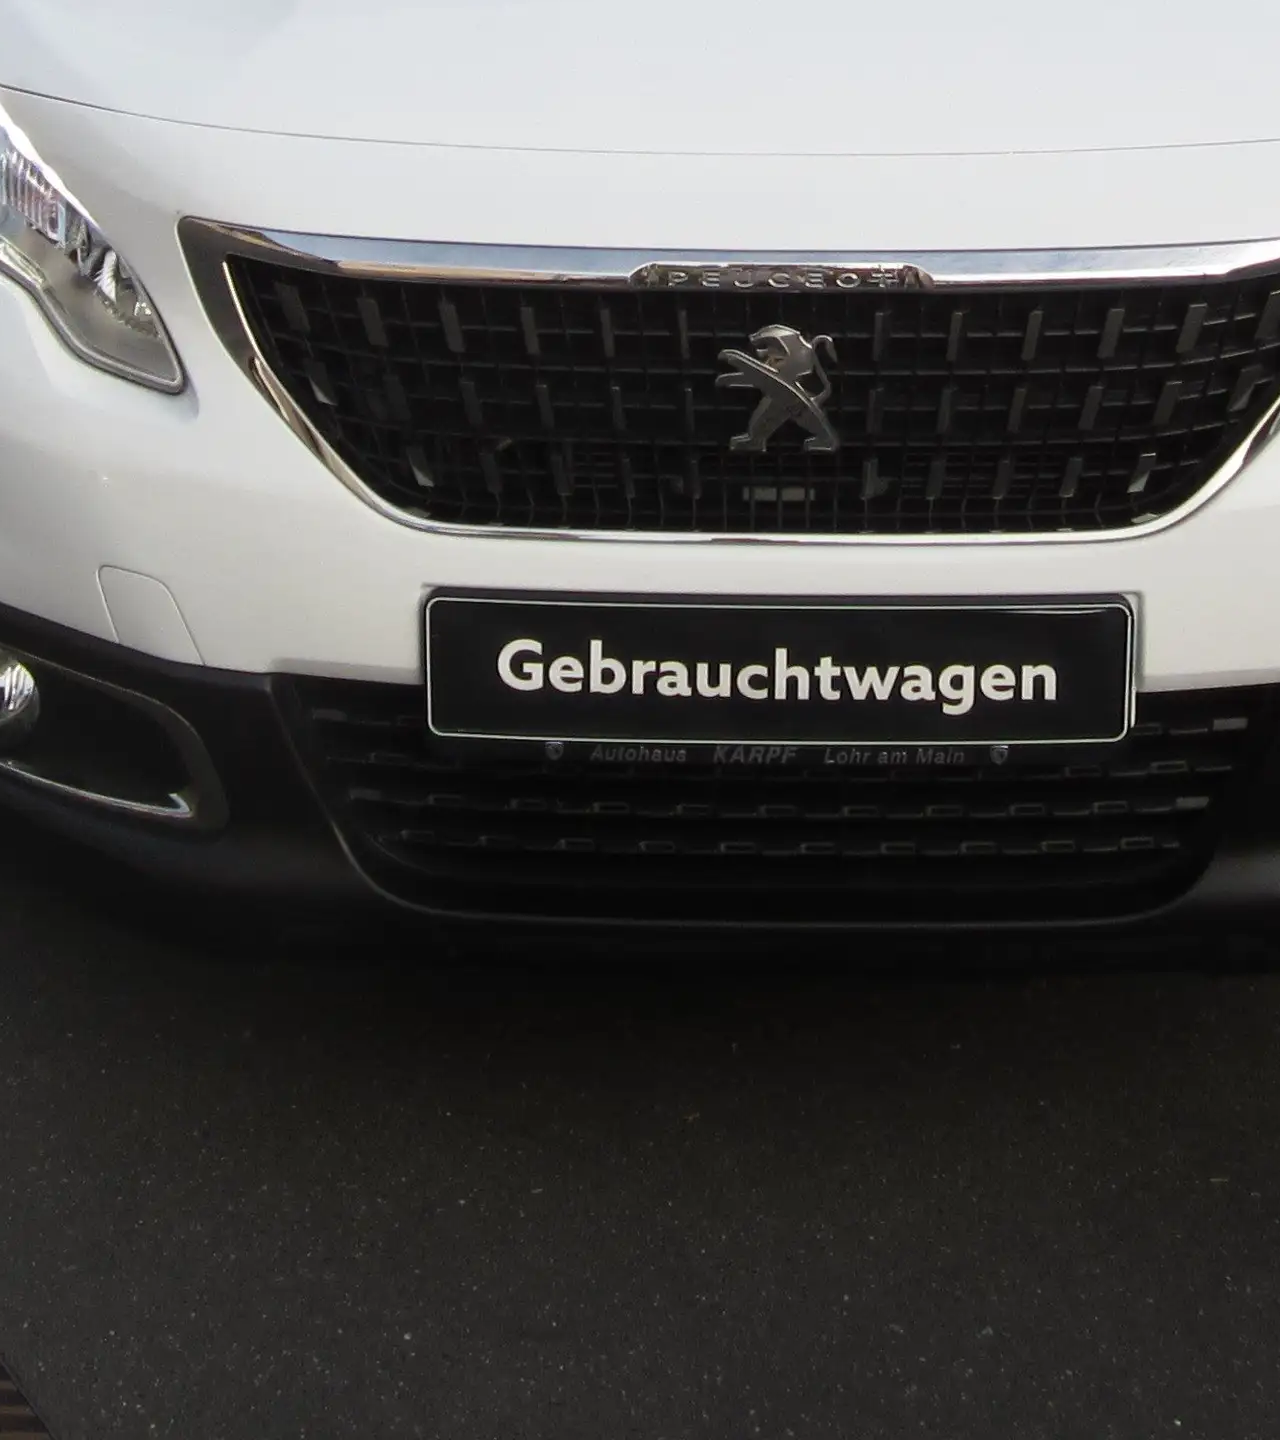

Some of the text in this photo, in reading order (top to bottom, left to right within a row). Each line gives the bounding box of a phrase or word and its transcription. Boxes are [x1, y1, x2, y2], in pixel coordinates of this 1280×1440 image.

[668, 269, 898, 288] PEUGEOT
[497, 639, 1056, 715] Gebrauchtwagen
[590, 744, 965, 765] Autohaus KARPF Lohr am Main
